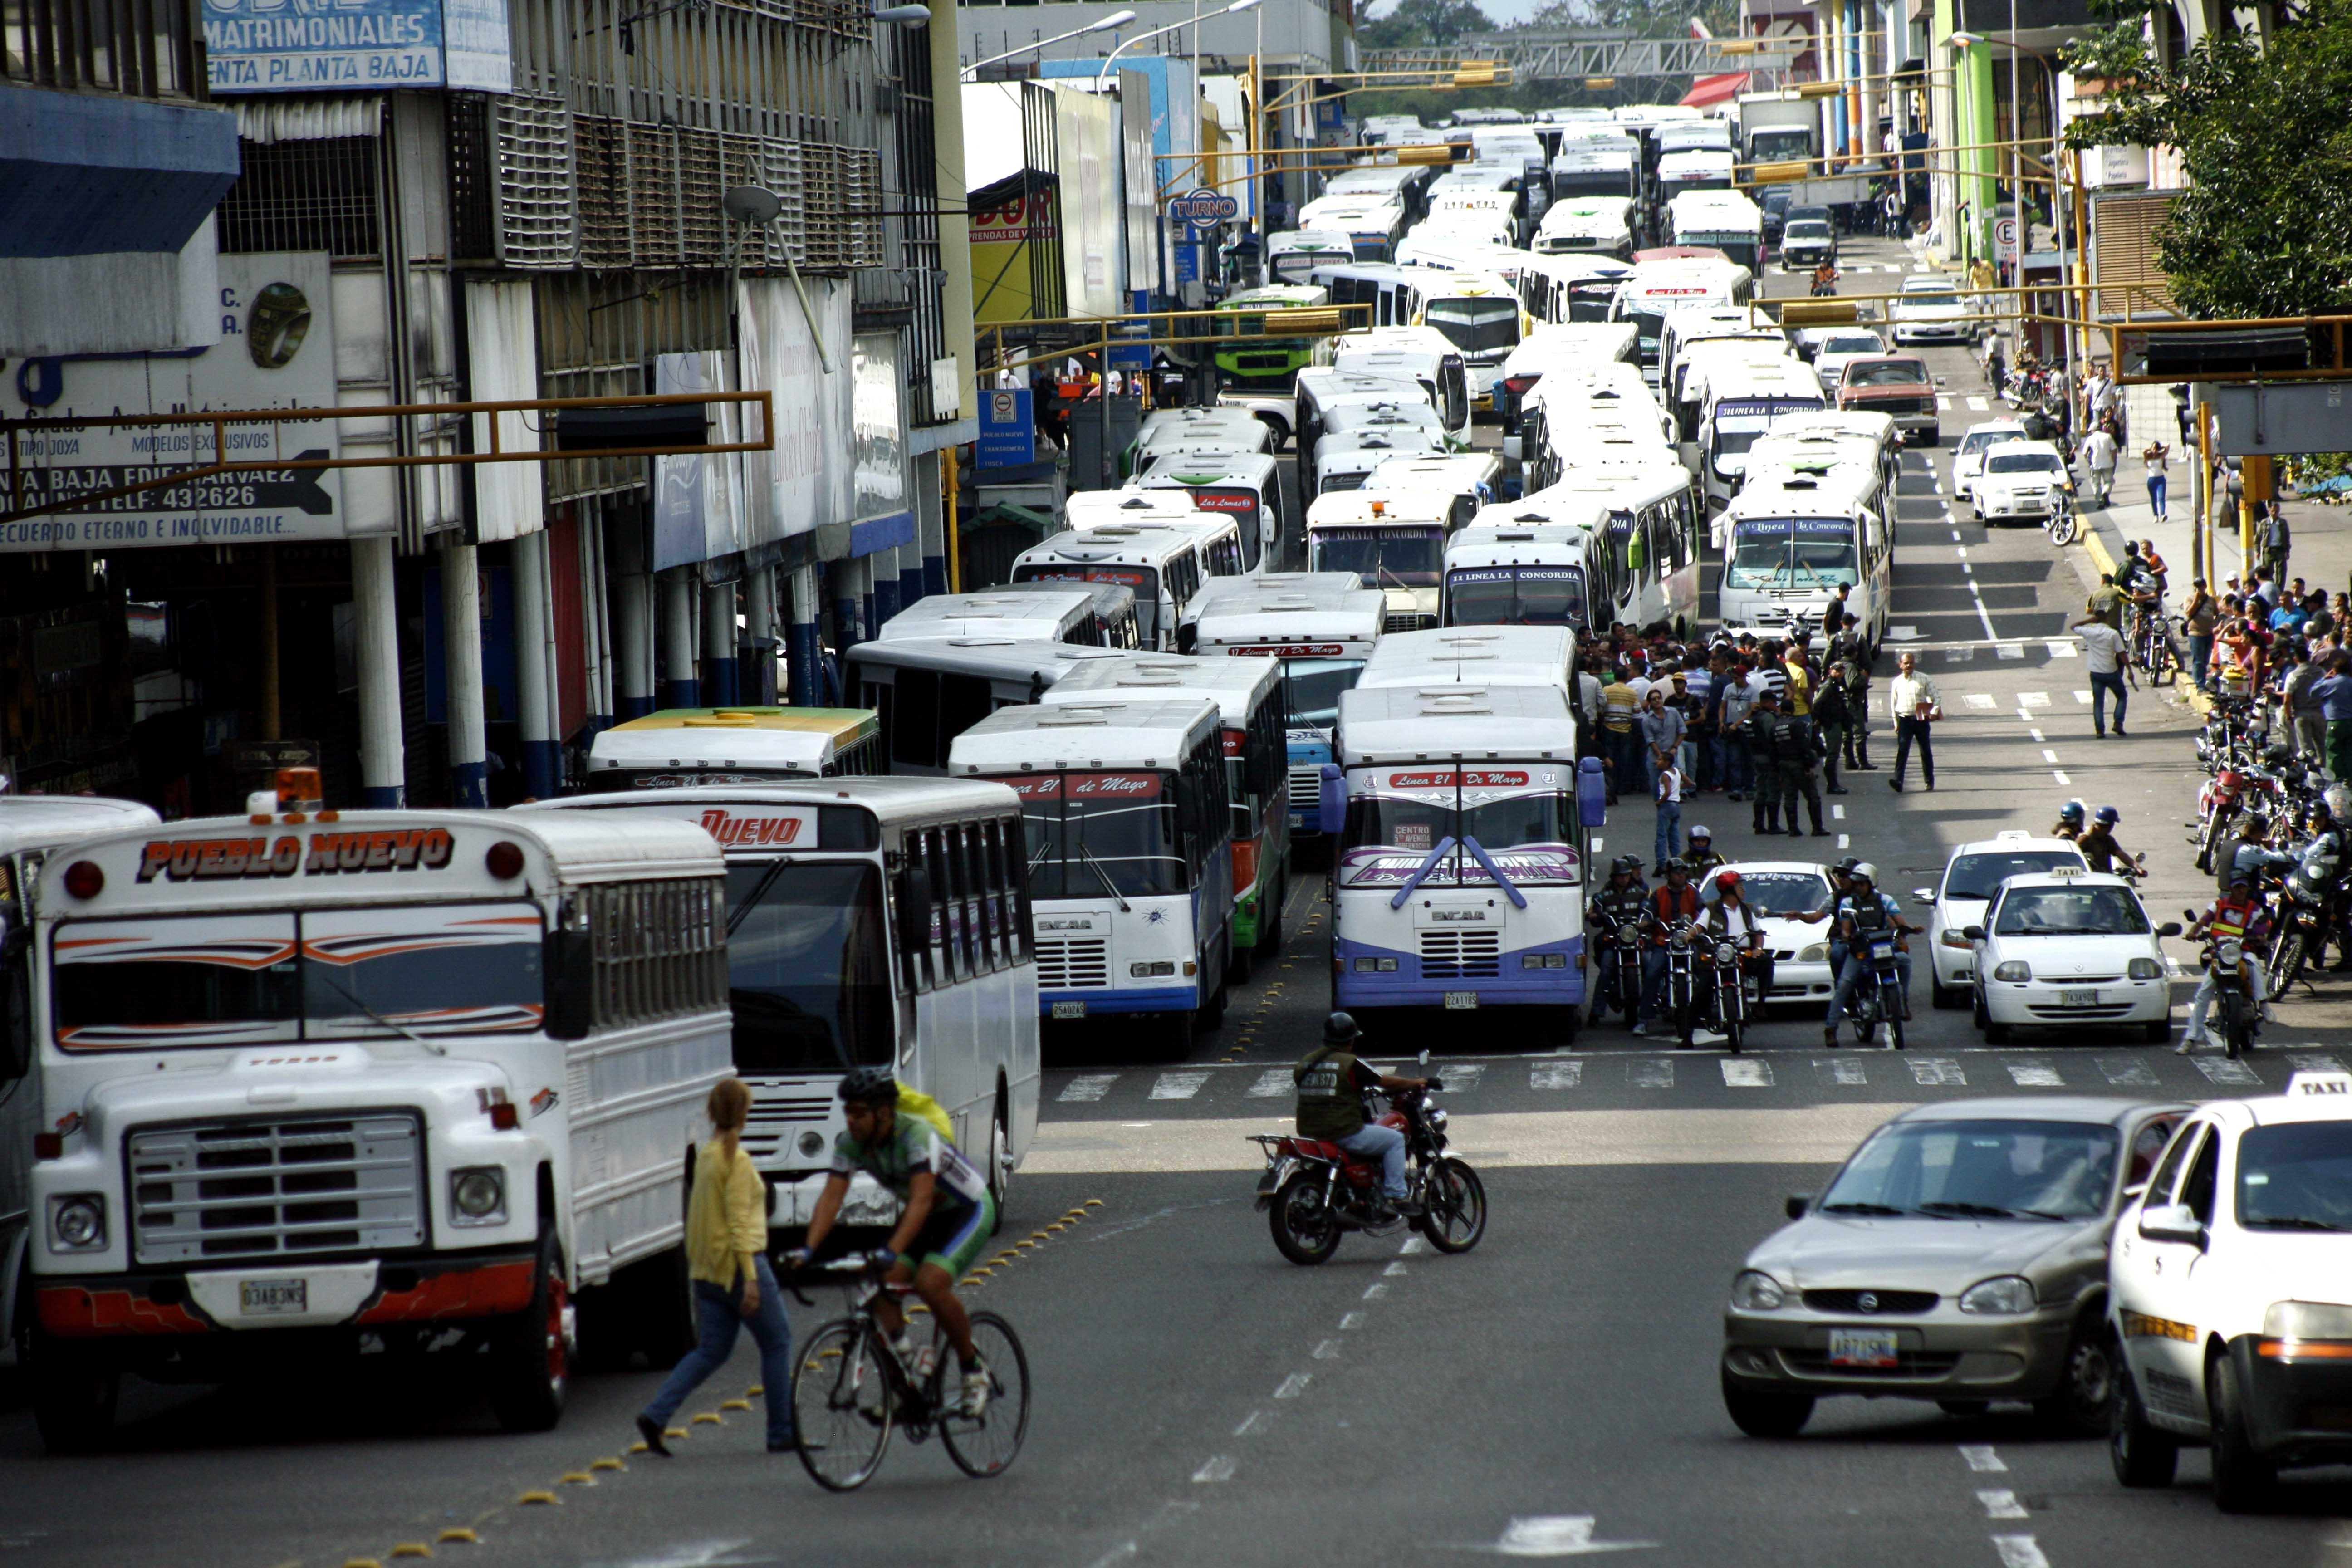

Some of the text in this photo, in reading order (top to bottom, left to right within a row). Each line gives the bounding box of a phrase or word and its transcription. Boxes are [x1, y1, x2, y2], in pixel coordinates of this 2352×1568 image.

[203, 15, 424, 49] MATRIMONIALES
[269, 57, 358, 82] PLANTA
[368, 55, 430, 78] BAJA
[1174, 200, 1235, 217] TURNO
[969, 230, 1007, 240] PRENDAS
[1009, 230, 1019, 239] DE
[220, 287, 240, 308] C.
[222, 314, 243, 334] A.
[1730, 407, 1754, 416] LINEA
[1756, 407, 1766, 415] LA
[20, 440, 44, 456] TIPO
[47, 439, 79, 455] JOYA
[132, 433, 269, 452] MODELOS EXCUSIVOS
[51, 469, 113, 490] BAJA
[163, 486, 255, 507] 432626
[1200, 499, 1215, 507] Las
[1217, 498, 1242, 507] Lomas
[85, 519, 148, 540] ETERNO
[156, 519, 164, 537] E
[1379, 529, 1427, 539] CONCORDIA
[1519, 572, 1579, 581] CONCORDIA
[1309, 646, 1339, 654] Mayo
[1037, 779, 1059, 793] 21
[1076, 780, 1096, 793] de
[1100, 777, 1147, 793] Mayo
[1396, 773, 1523, 786] Linea 21 De Mayo
[1395, 826, 1430, 834] CENTRO
[136, 828, 455, 884] PUEBLO NUEVO
[1424, 872, 1549, 884] Purgaorio
[1431, 911, 1486, 921] ENCAVA
[1038, 920, 1093, 931] ENCAVA
[2301, 1081, 2347, 1096] TAXI
